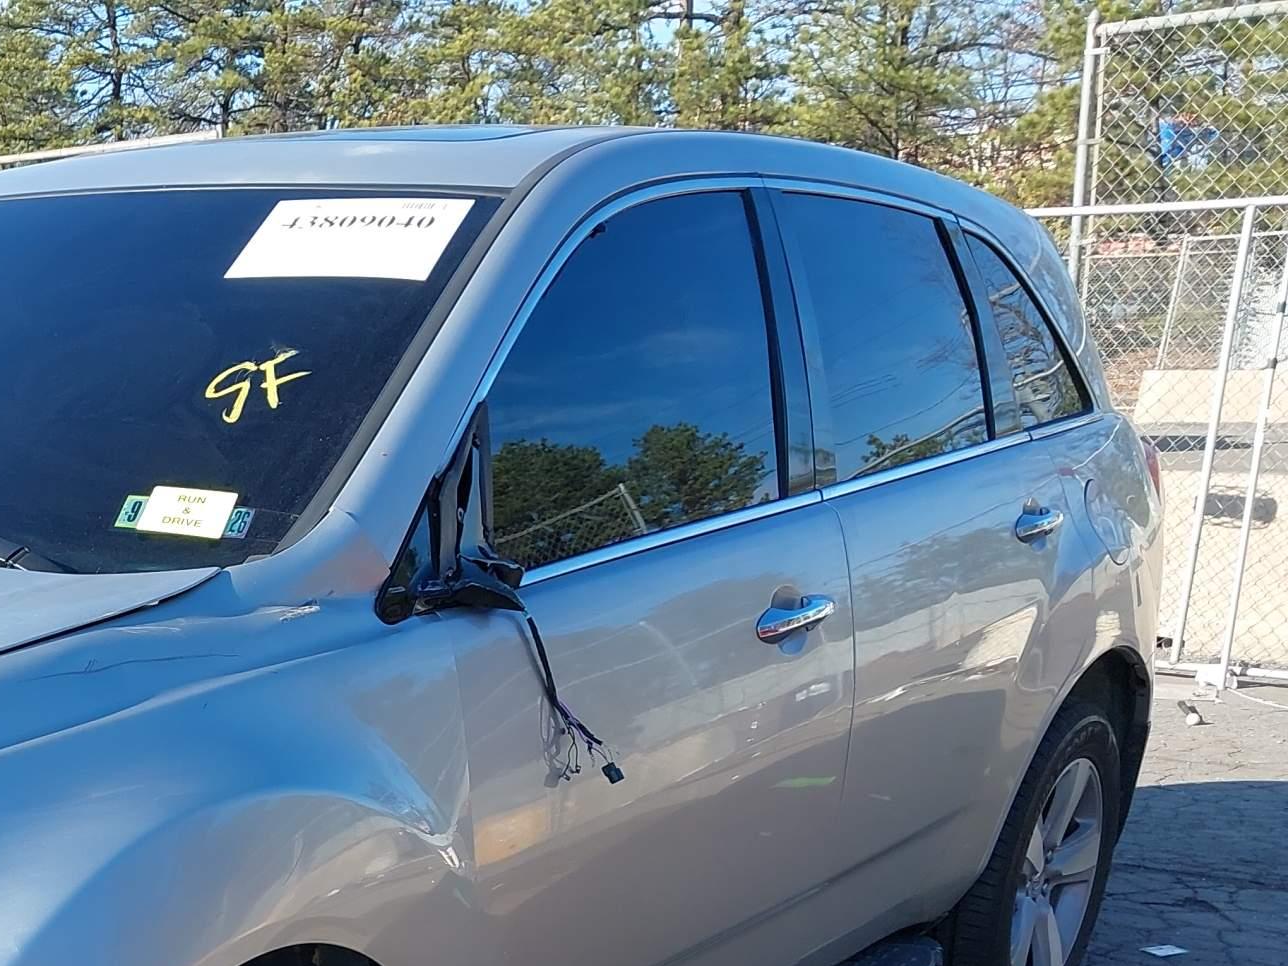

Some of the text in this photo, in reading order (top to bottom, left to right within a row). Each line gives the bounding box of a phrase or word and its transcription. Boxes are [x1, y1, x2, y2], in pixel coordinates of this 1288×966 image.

[177, 495, 208, 504] RUN
[127, 500, 143, 523] 9
[182, 507, 191, 515] &
[161, 516, 203, 528] DRIVE
[228, 510, 250, 533] 26
